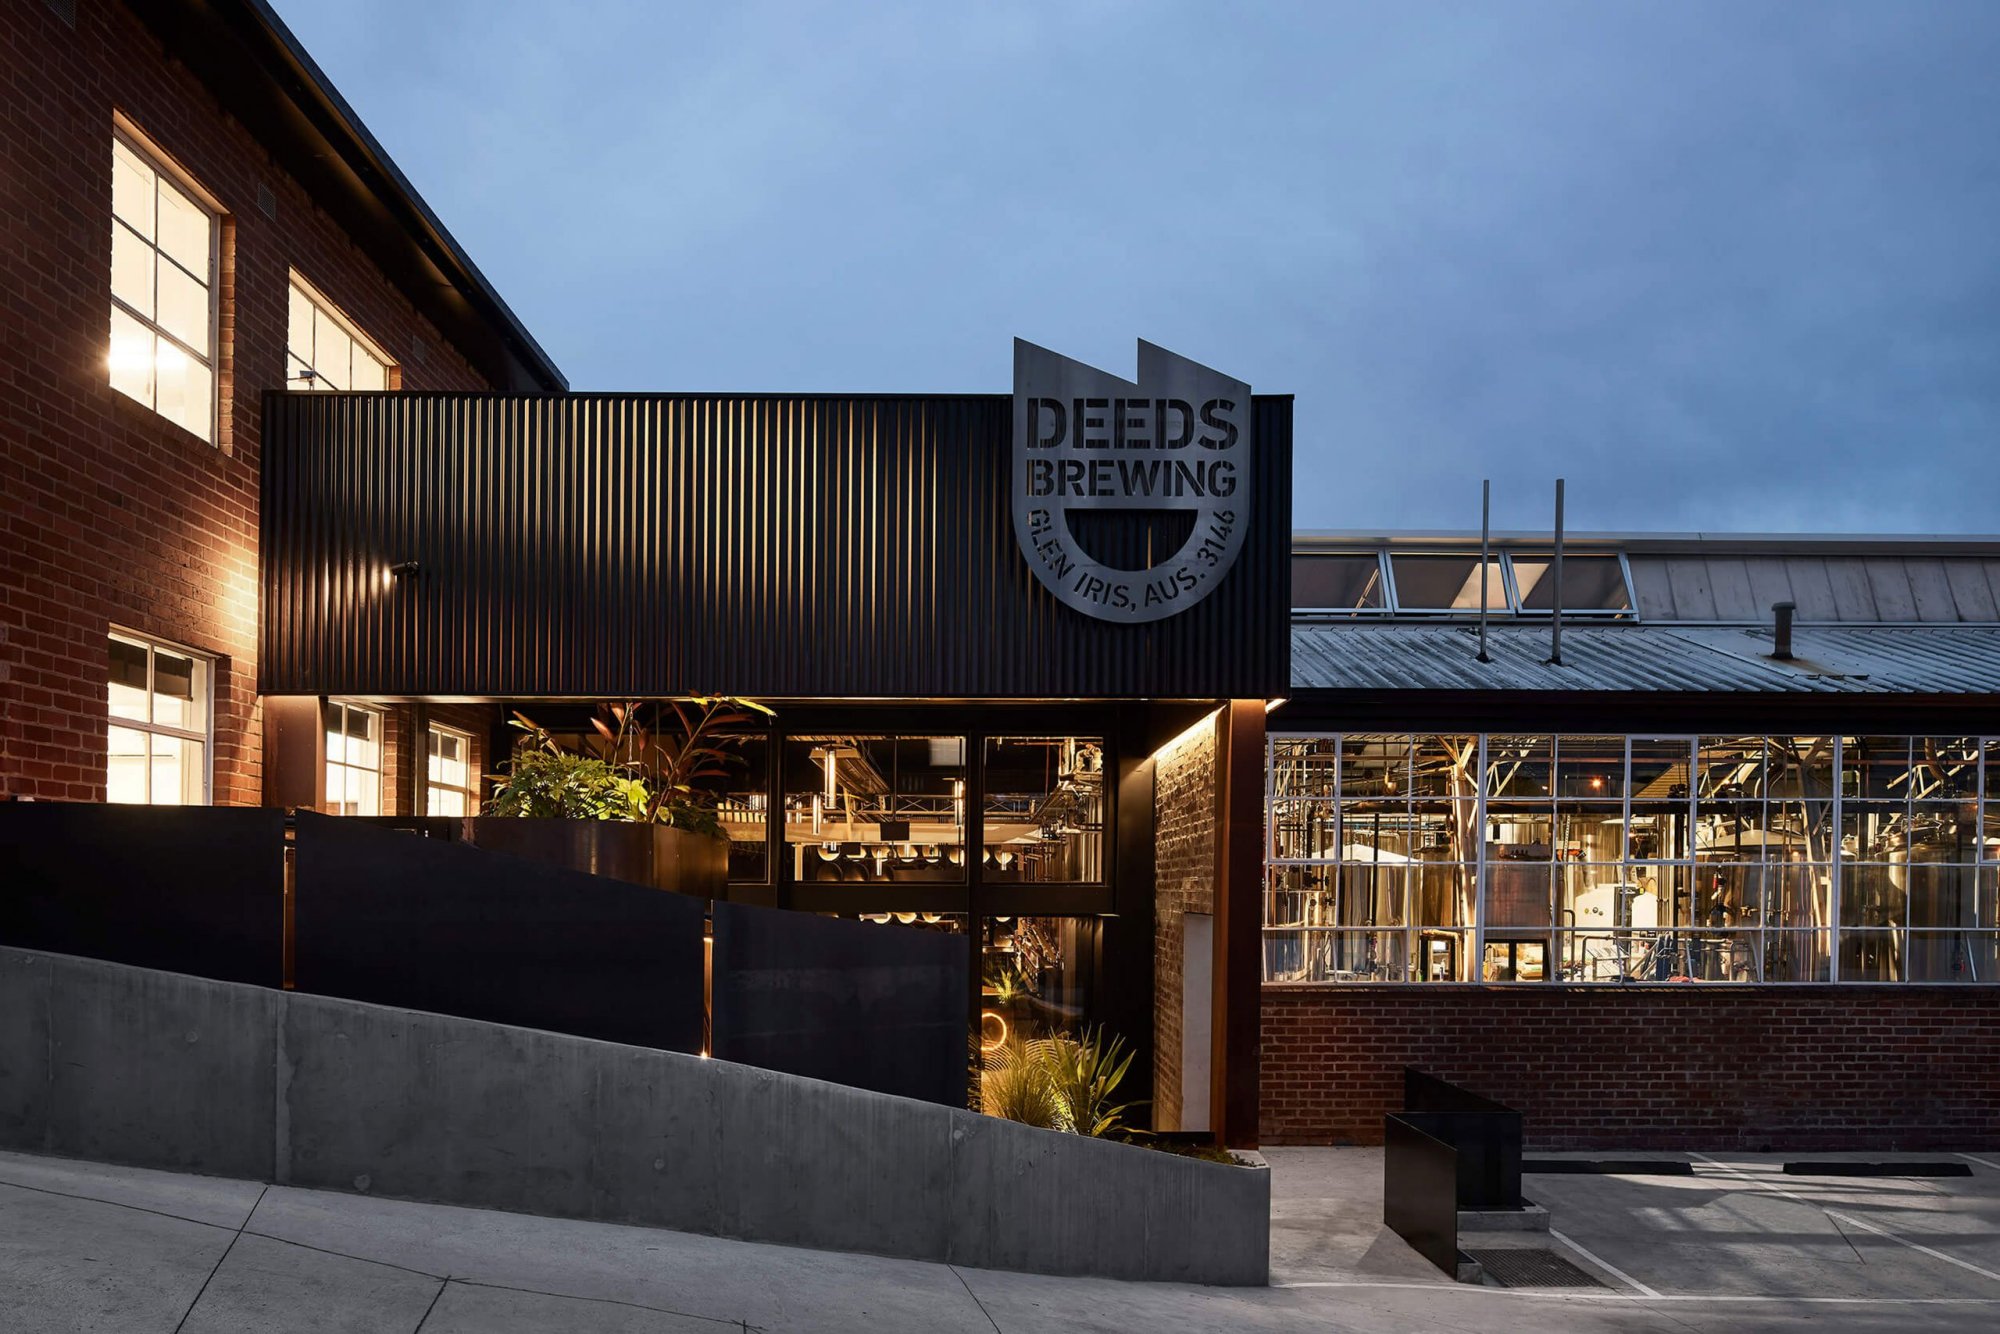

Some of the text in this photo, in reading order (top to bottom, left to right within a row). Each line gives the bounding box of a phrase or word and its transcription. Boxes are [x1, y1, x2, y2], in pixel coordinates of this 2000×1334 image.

[1026, 398, 1239, 450] DEEDS
[1026, 459, 1237, 498] BREWING
[1027, 509, 1235, 612] GLEN IRIS, AUS. 3146
